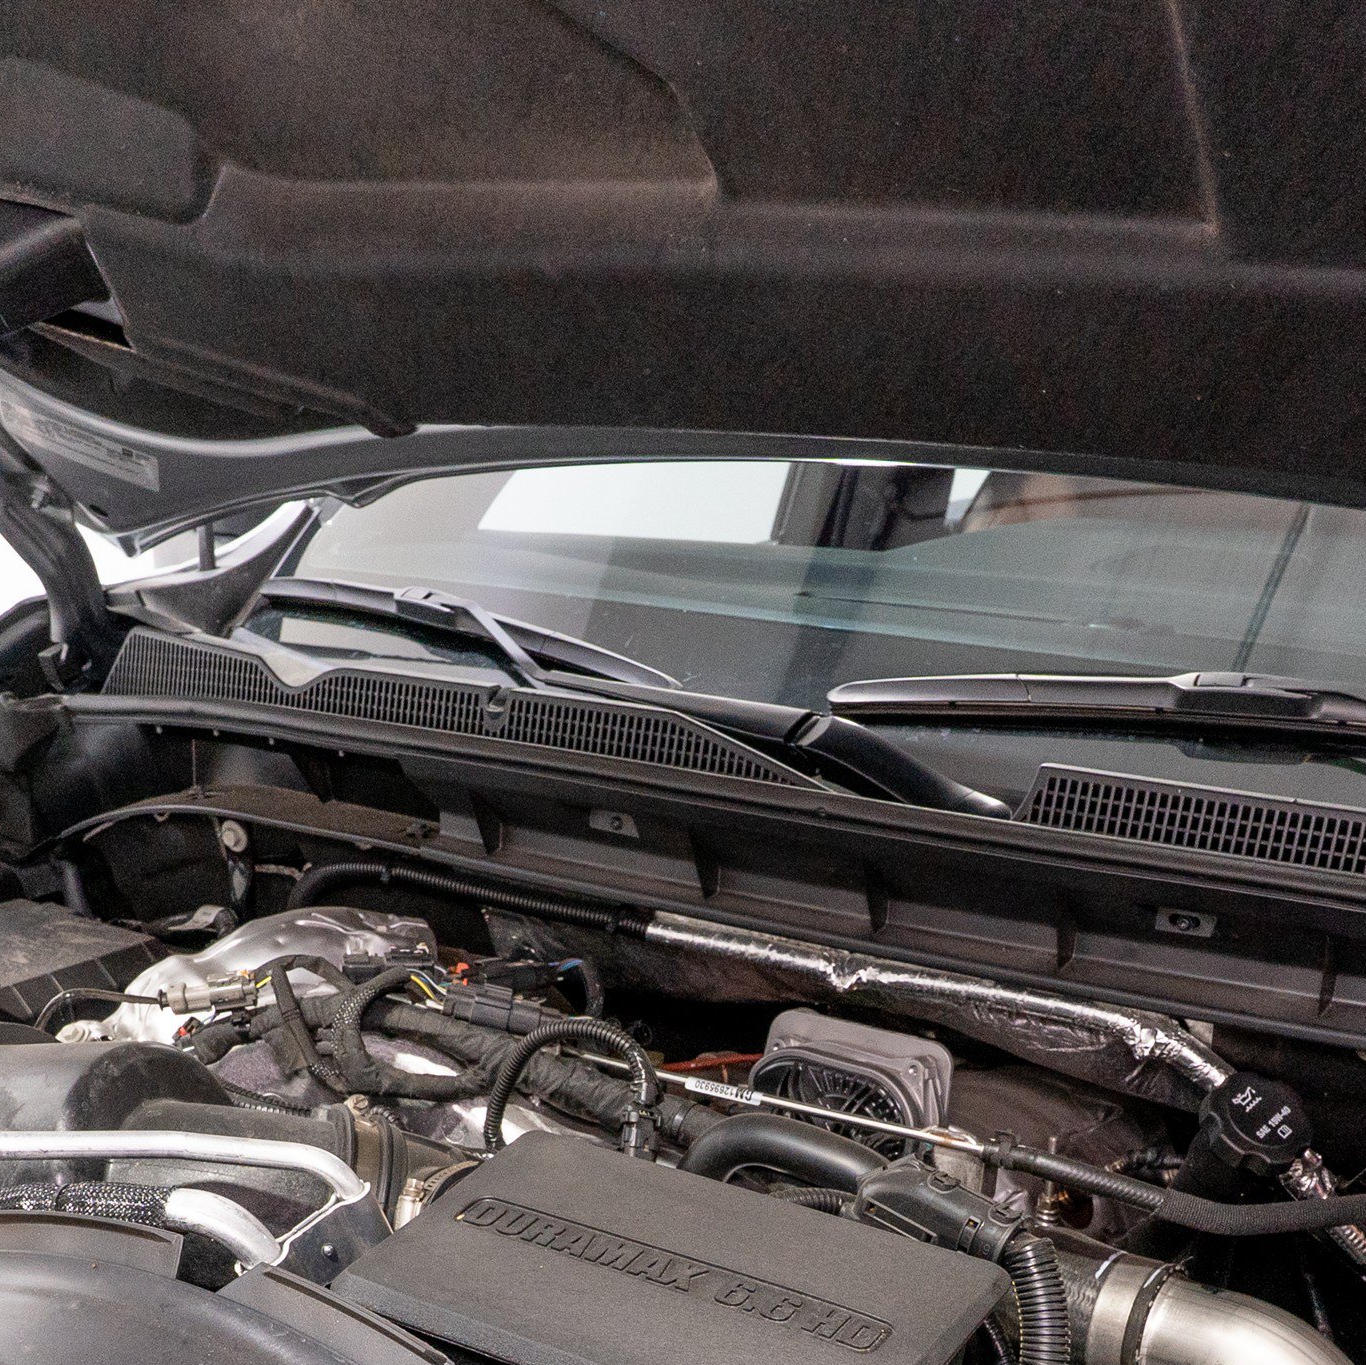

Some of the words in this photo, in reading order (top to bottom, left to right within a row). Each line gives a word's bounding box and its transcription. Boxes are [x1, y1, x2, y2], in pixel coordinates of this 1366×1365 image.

[735, 1086, 754, 1101] GM
[464, 1202, 712, 1291] DURAMAX
[714, 1280, 800, 1323] 6.6
[801, 1307, 888, 1351] HD
